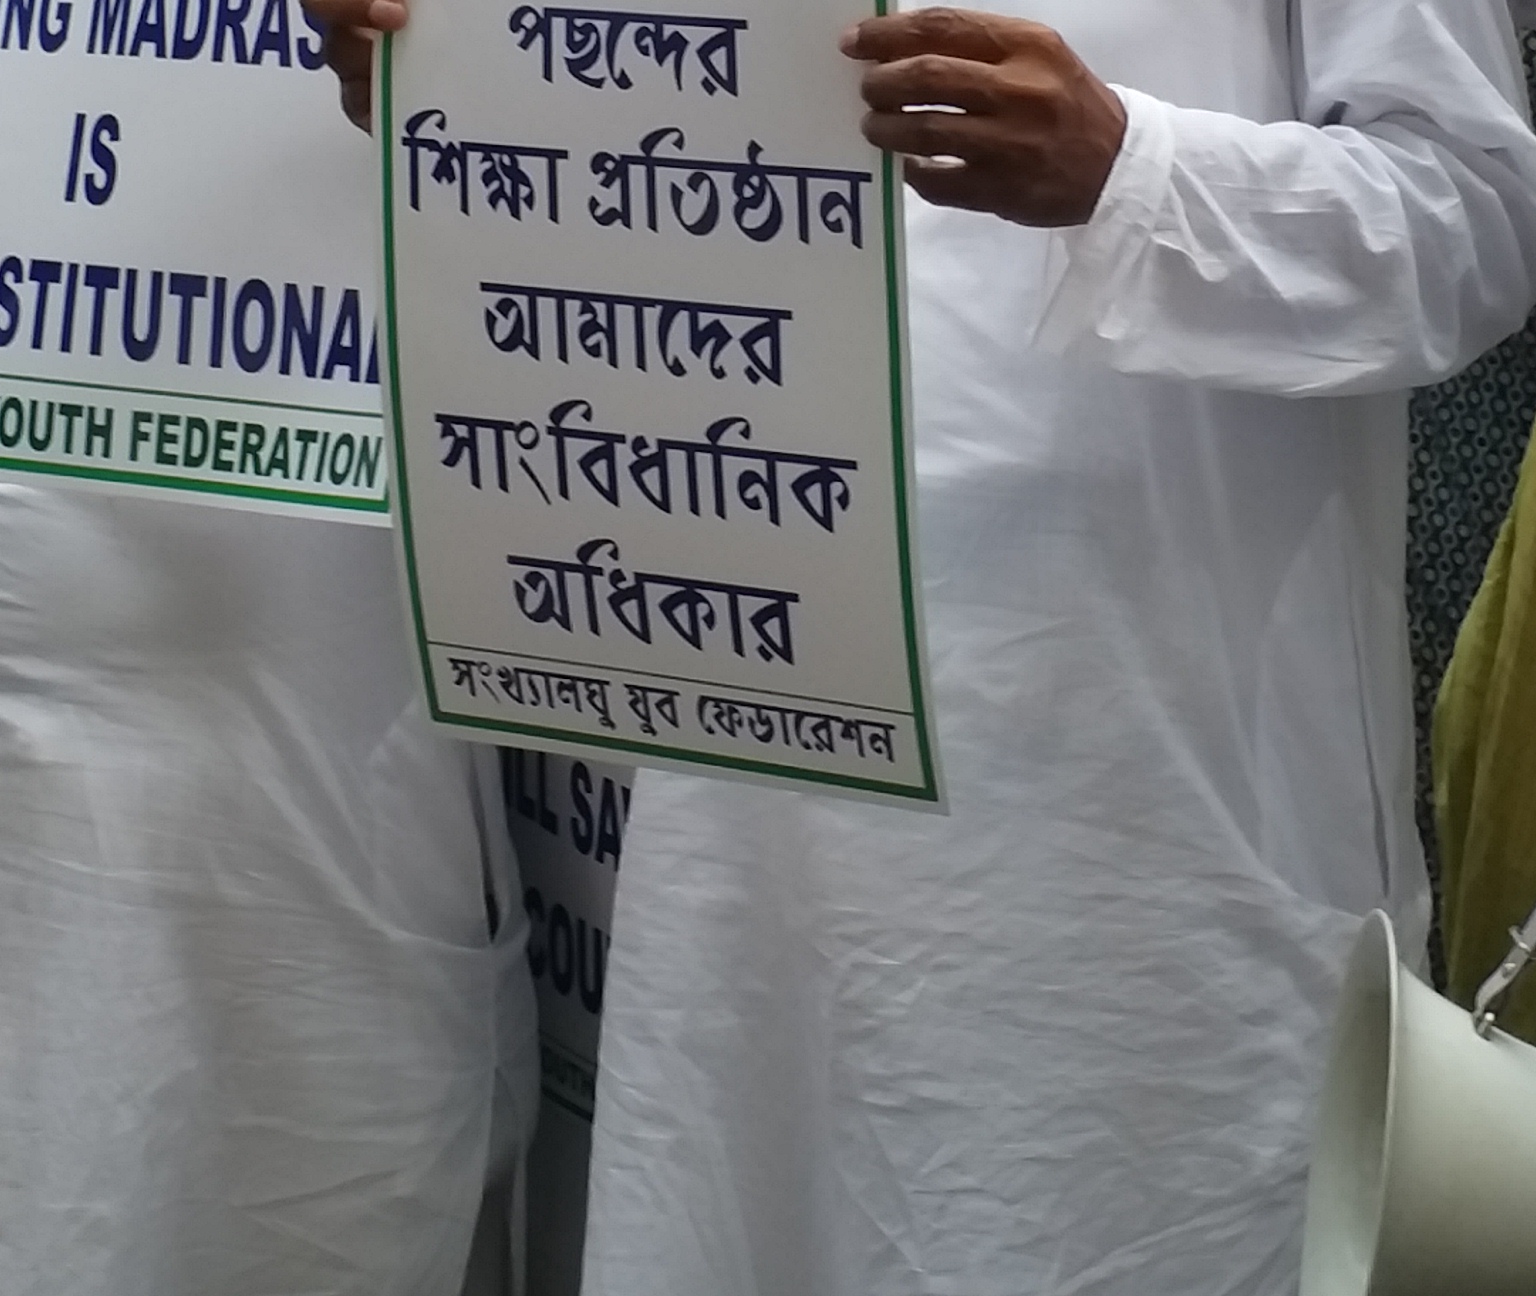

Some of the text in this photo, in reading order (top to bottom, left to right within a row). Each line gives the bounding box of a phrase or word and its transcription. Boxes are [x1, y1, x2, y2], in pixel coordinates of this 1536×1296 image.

[508, 5, 747, 97] পছন্দের
[65, 113, 119, 205] IS
[402, 109, 871, 252] শিক্ষা প্রতিষ্ঠান
[480, 282, 792, 386] আমাদের
[129, 411, 384, 489] FEDERATION
[435, 401, 857, 533] সাংবিধানিক
[507, 540, 798, 667] অধিকার
[447, 656, 895, 763] সংখ্যালঘু যুব ফেডারেশন
[571, 760, 629, 872] SA
